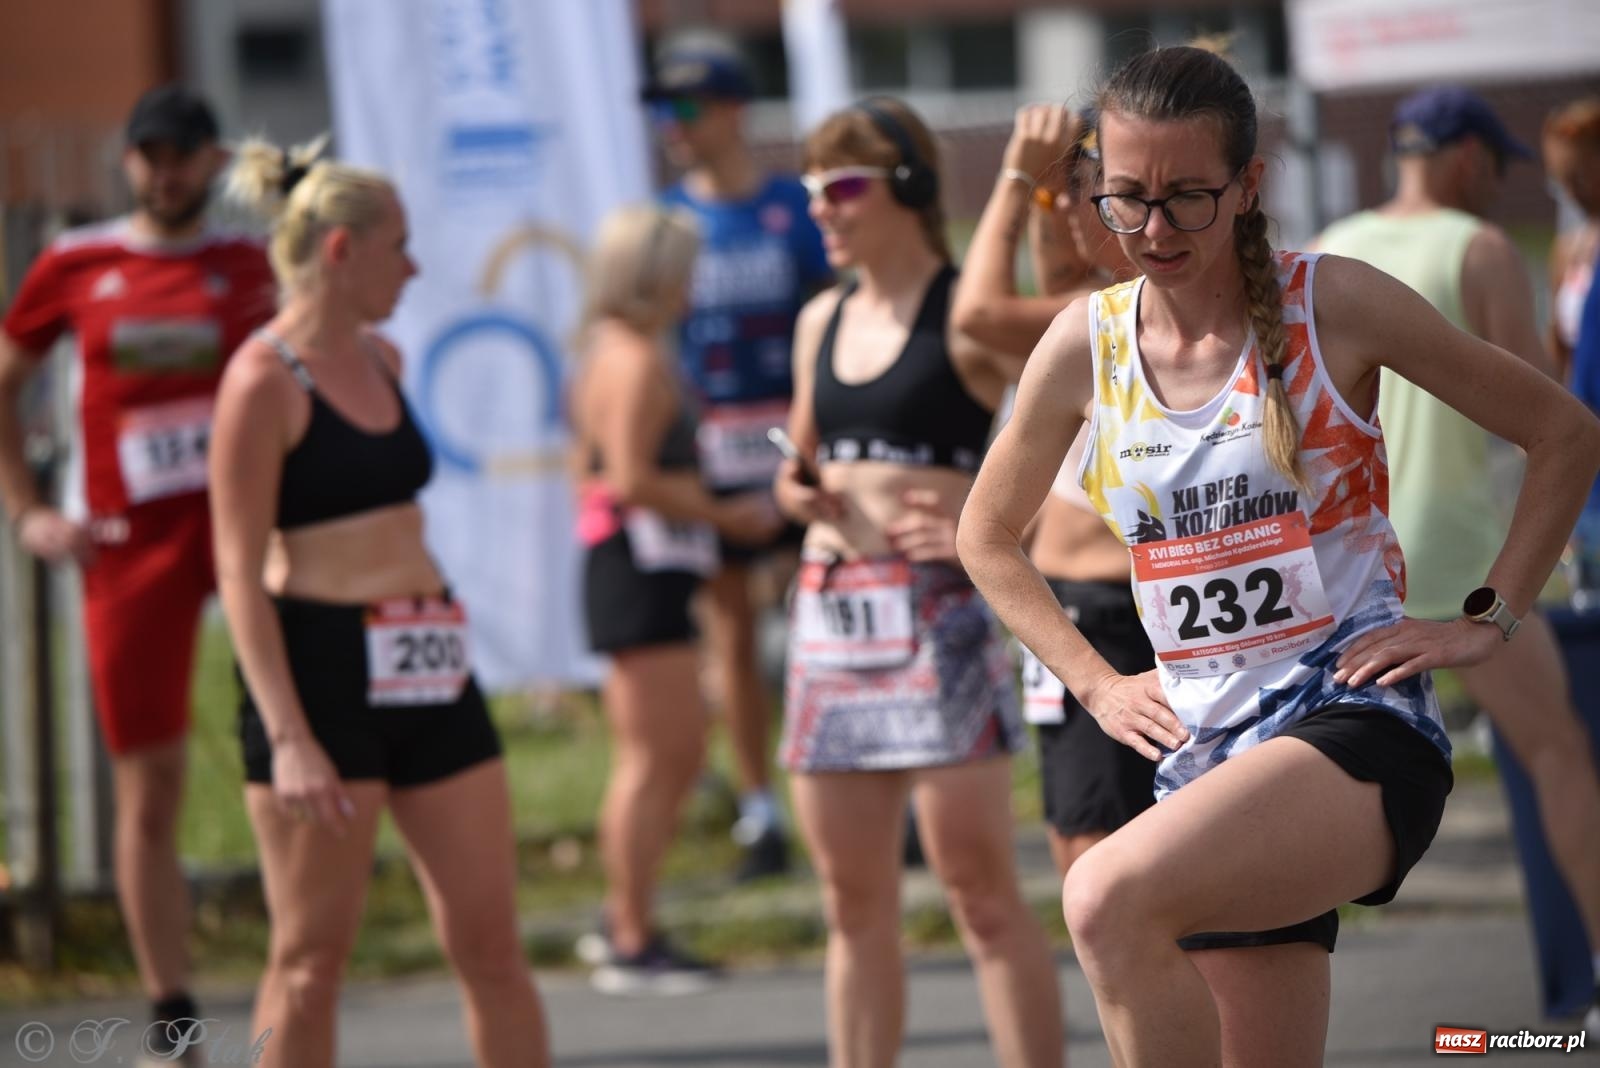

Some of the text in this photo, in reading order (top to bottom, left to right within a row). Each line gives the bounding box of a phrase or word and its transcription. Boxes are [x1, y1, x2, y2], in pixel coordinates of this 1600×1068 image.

[1170, 489, 1298, 539] KOZIOŁKÓW
[1172, 473, 1249, 515] XII BIEG
[1148, 522, 1282, 561] XVI BIEG BEZ GRANIC
[1169, 567, 1294, 641] 232
